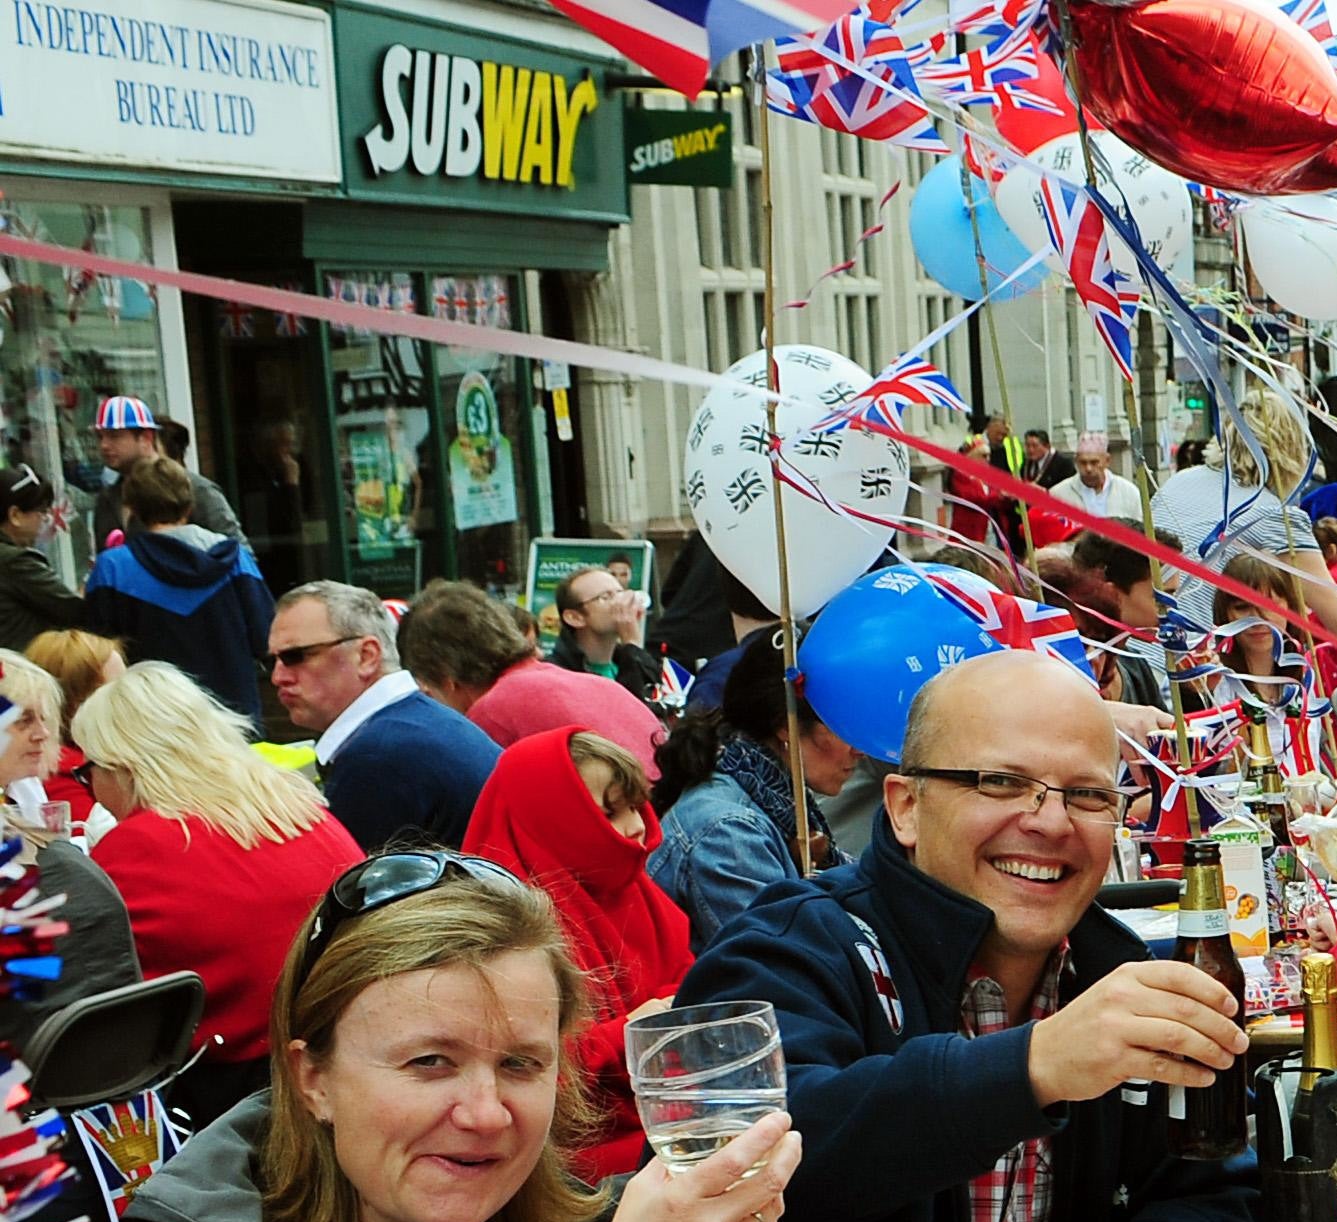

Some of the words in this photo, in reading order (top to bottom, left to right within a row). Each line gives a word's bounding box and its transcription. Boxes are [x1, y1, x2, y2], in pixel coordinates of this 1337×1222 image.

[13, 0, 188, 69] INDEPENDENT
[199, 29, 320, 89] INSURANCE
[114, 79, 208, 133] BUREAU
[214, 92, 256, 137] LTD
[365, 43, 597, 191] SUBWAY
[630, 123, 726, 174] SUBWAY
